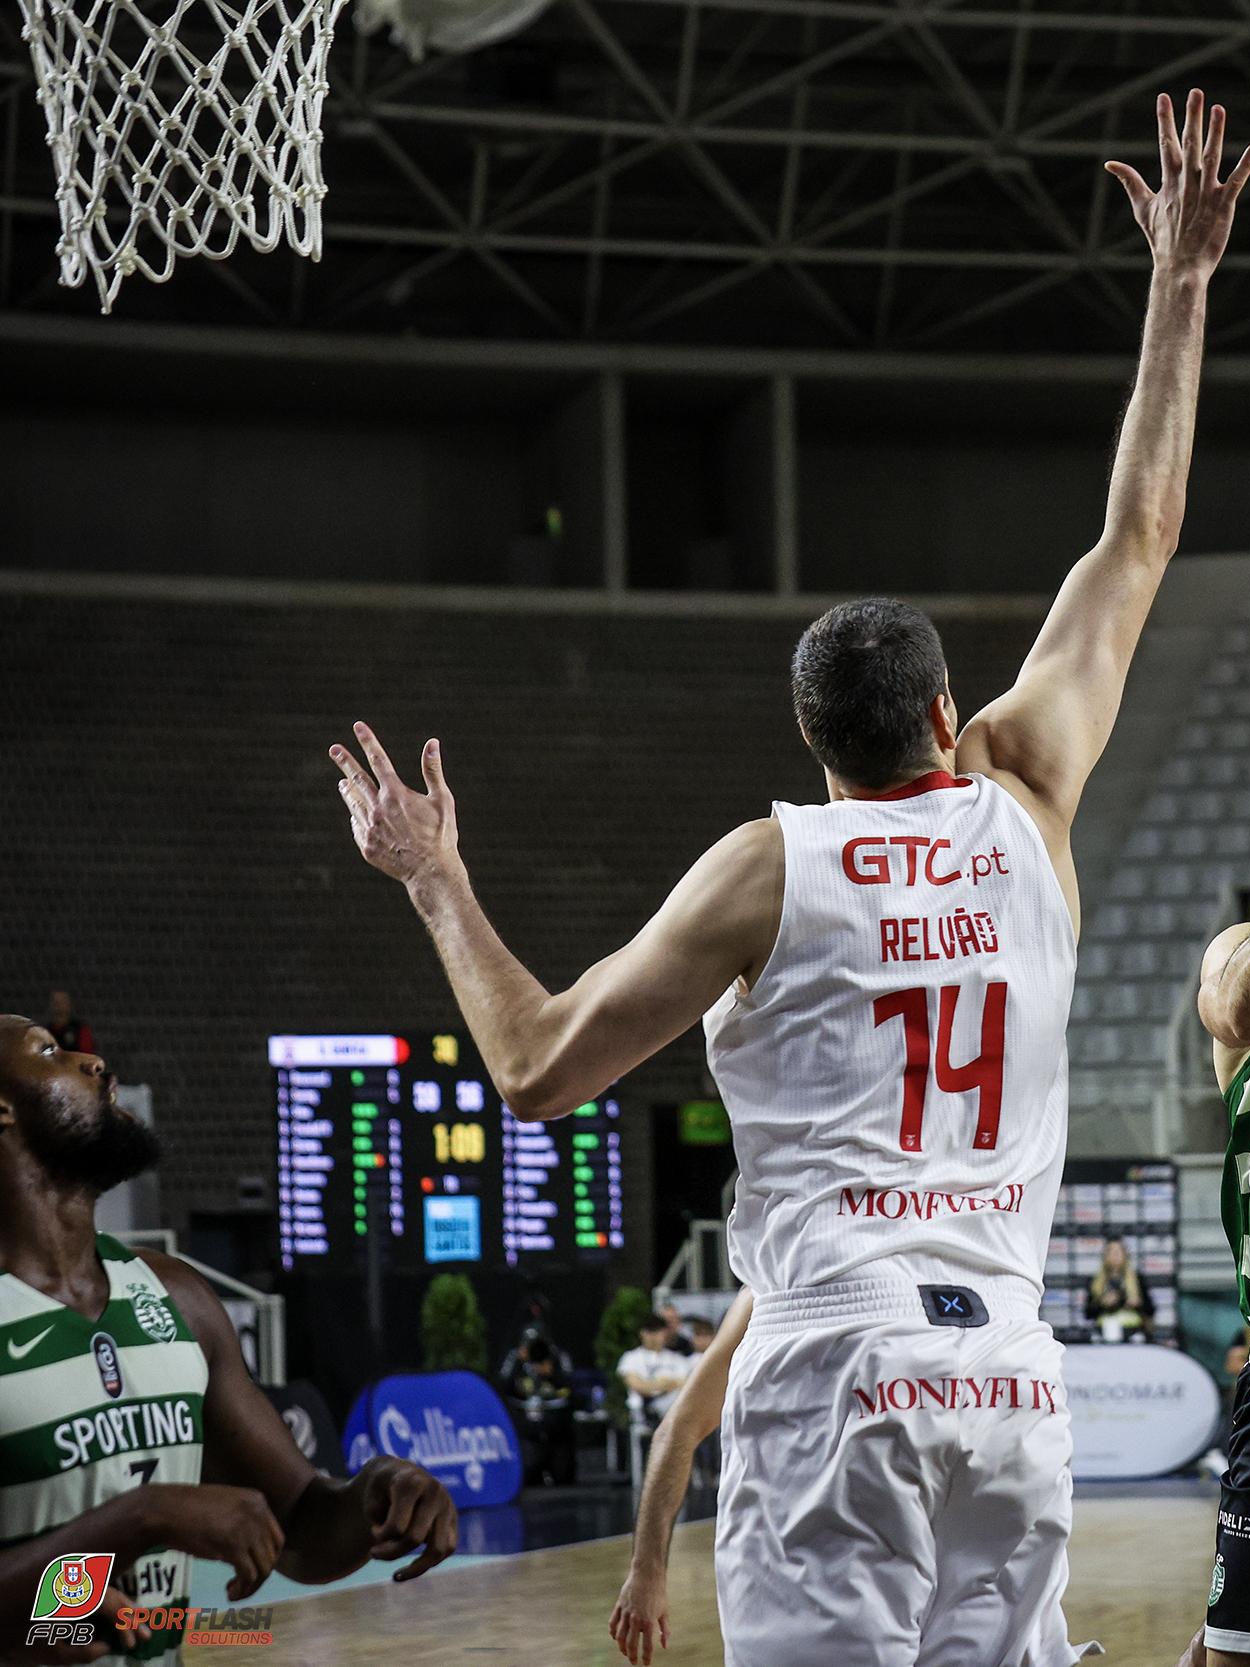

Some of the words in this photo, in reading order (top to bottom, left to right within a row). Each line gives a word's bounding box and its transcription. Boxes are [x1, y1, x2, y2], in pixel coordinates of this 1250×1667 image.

[841, 836, 1009, 887] GTC.pt
[880, 907, 999, 963] RELVÃO
[873, 981, 1008, 1152] 14
[54, 1400, 194, 1470] SPORTING
[379, 1405, 513, 1493] Culligan
